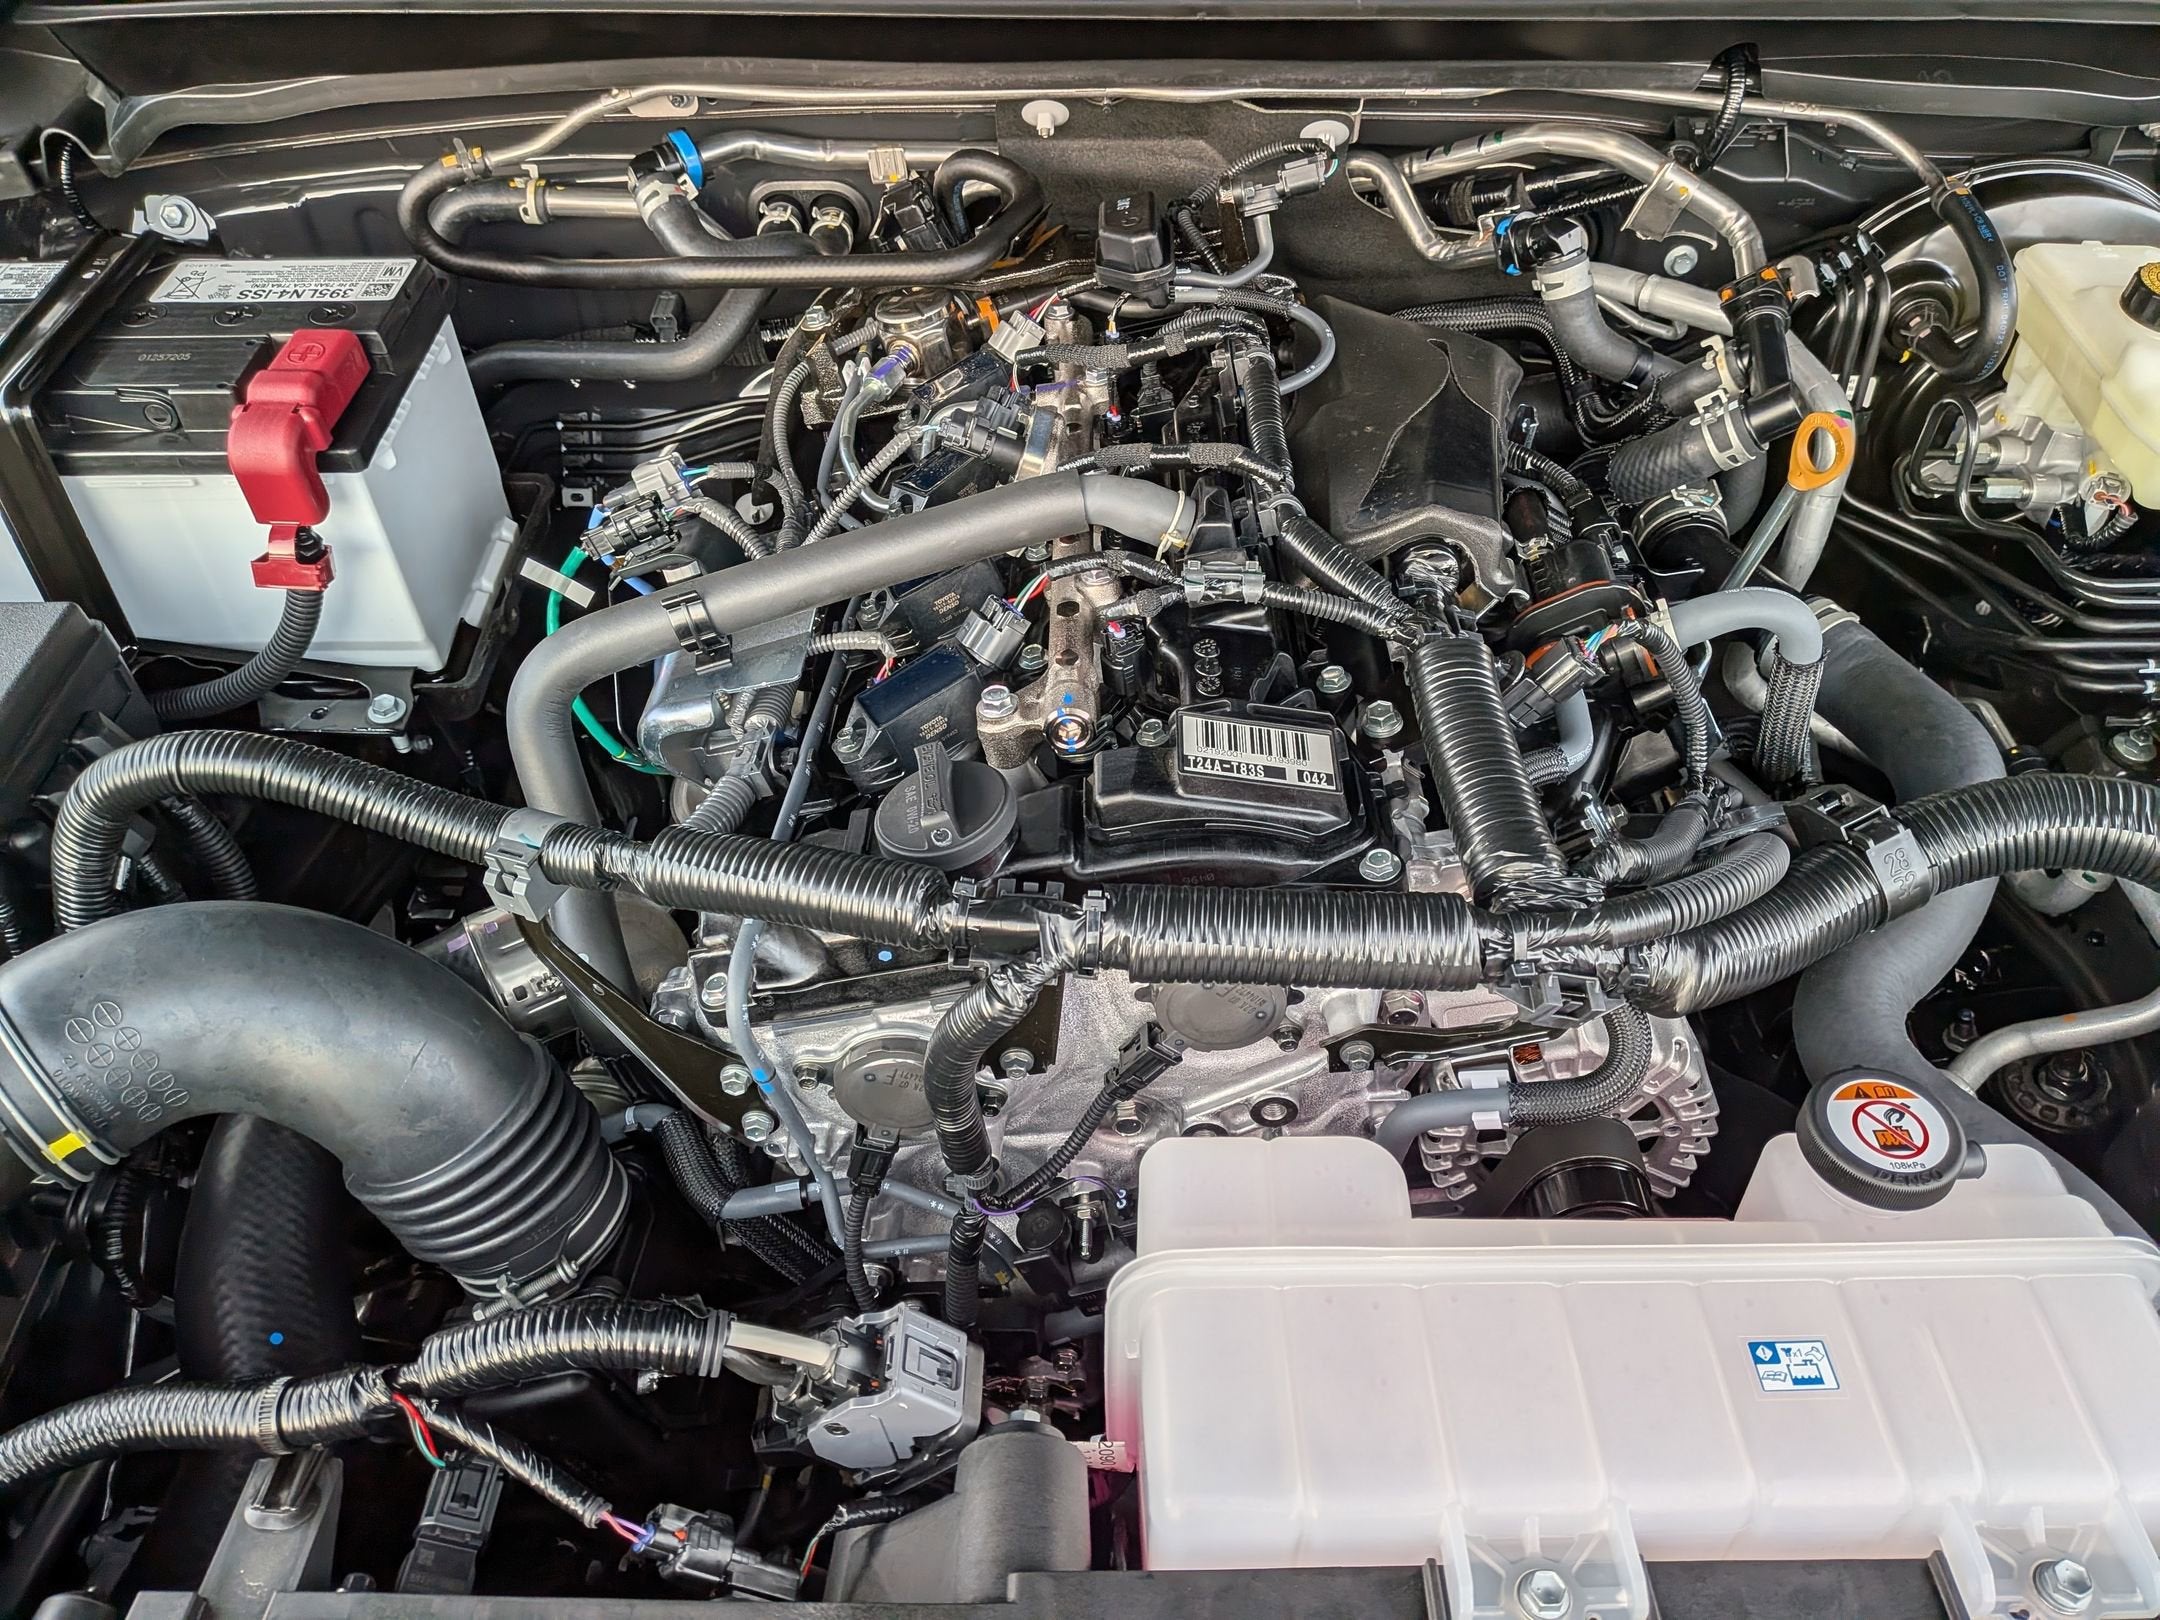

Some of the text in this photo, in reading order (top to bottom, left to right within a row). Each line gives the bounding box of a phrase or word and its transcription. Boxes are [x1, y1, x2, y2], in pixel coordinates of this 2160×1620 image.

[382, 266, 403, 276] VM
[1995, 265, 2008, 282] DOT
[236, 288, 354, 300] 395LN4-ISS
[934, 592, 956, 606] TOYOTA
[938, 600, 960, 615] DENSO
[920, 716, 943, 731] TOYOTA
[926, 723, 947, 740] DENSO
[1196, 746, 1308, 767] 02192001 0193980
[1187, 755, 1328, 785] T24A-T83S 042
[904, 785, 918, 804] SAE
[1883, 847, 1911, 878] 28
[1893, 870, 1918, 896] 32
[1889, 1161, 1926, 1171] 108kPa
[1872, 1168, 1943, 1187] DENSO
